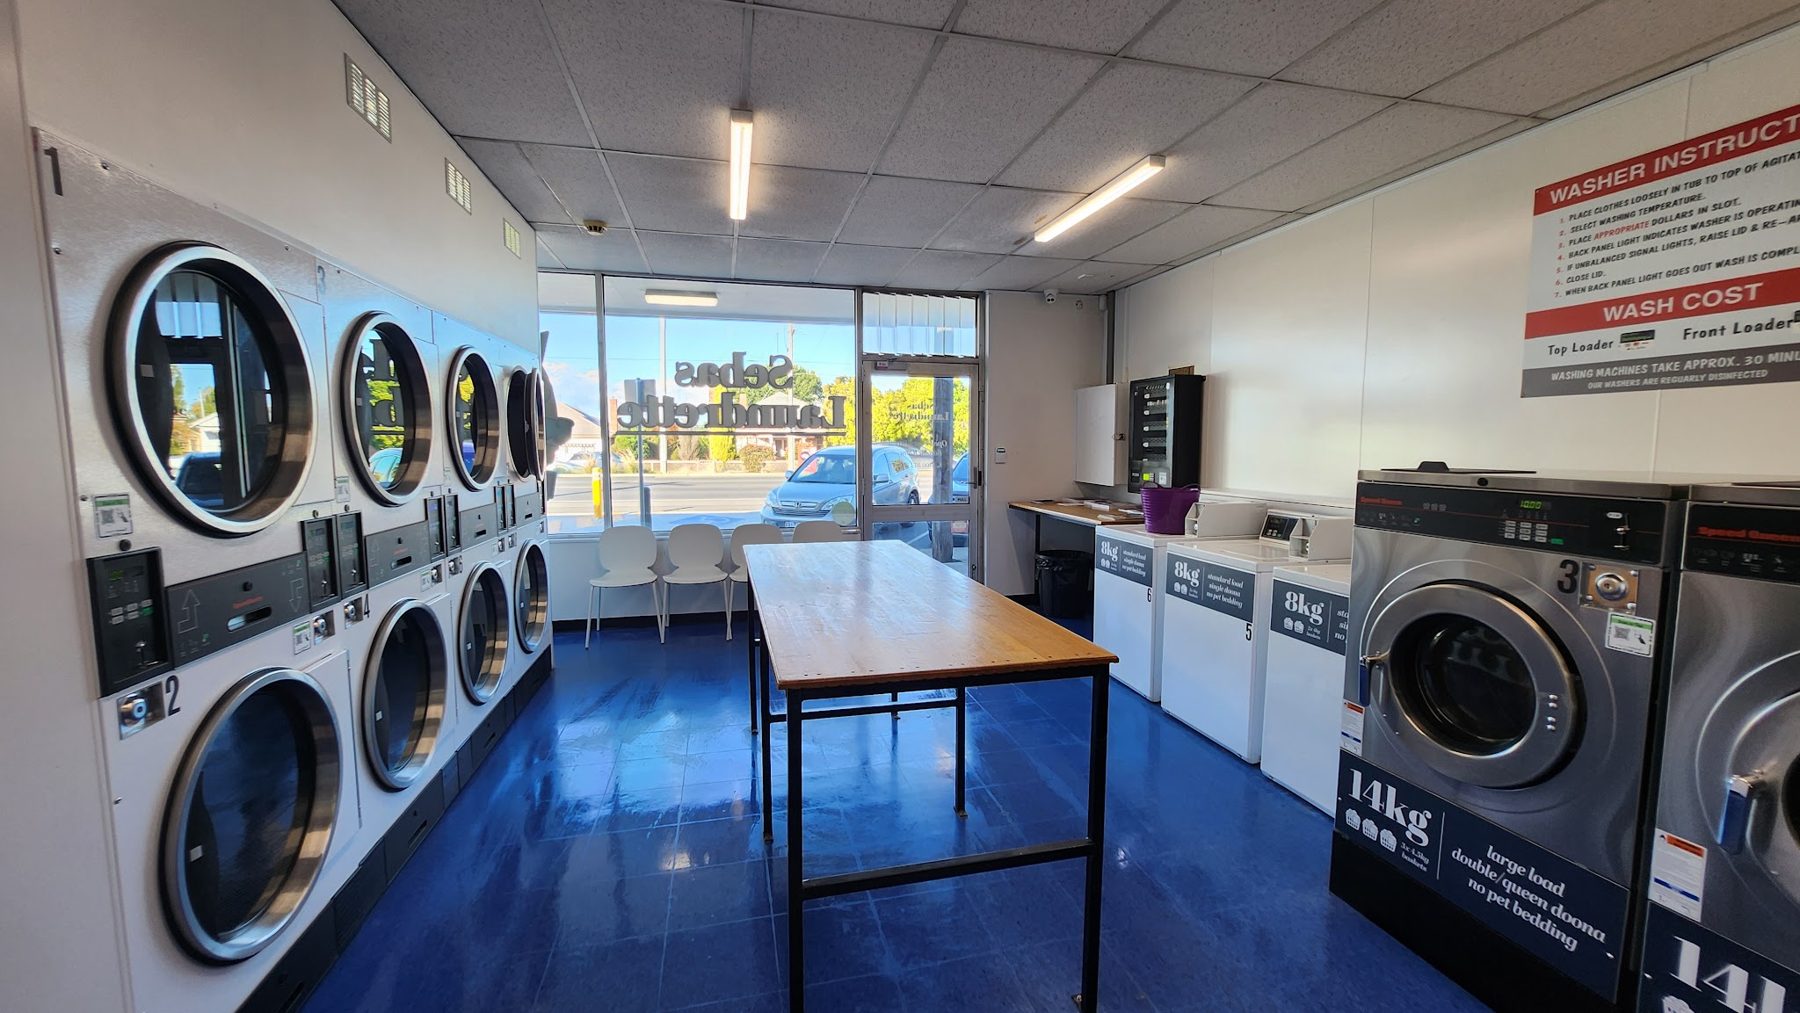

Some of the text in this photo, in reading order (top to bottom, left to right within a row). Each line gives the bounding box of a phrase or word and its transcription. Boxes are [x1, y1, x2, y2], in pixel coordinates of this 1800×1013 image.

[44, 147, 63, 196] 1
[1550, 114, 1800, 204] WASHER INSTRUCT
[1569, 209, 1592, 221] PLACE
[1594, 199, 1629, 215] CLOTHES
[1631, 187, 1669, 204] LOOSELY
[1671, 184, 1681, 193] IN
[1684, 179, 1702, 190] TUB
[1705, 175, 1718, 184] TO
[1721, 167, 1741, 180] TOP
[1745, 162, 1758, 173] OF
[1568, 235, 1592, 246] PLACE
[1594, 220, 1649, 240] APPROPRIATE
[1651, 210, 1694, 226] DOLLARS
[1698, 206, 1708, 215] IN
[1711, 197, 1741, 211] SLOT.
[1570, 221, 1597, 234] SELECT
[1599, 211, 1636, 226] WASHING
[1639, 193, 1705, 216] TEMPERATURE.
[1567, 263, 1574, 271] IF
[1575, 252, 1626, 269] UNBALANCED
[1629, 246, 1659, 258] SIGNAL
[1661, 238, 1697, 252] LIGHTS,
[1700, 230, 1729, 243] RAISE
[1731, 226, 1748, 236] LID
[1751, 224, 1760, 232] &
[1568, 247, 1589, 259] BACK
[1591, 242, 1615, 254] PANEL
[1617, 236, 1640, 248] LIGHT
[1642, 225, 1688, 242] INDICATES
[1690, 215, 1731, 231] WASHER
[1734, 211, 1744, 221] IS
[1565, 286, 1586, 296] WHEN
[1588, 281, 1609, 292] BACK
[1611, 277, 1636, 288] PANEL
[1638, 271, 1663, 283] LIGHT
[1665, 266, 1690, 278] GOES
[1693, 262, 1713, 273] OUT
[1715, 256, 1745, 268] WASH
[1748, 254, 1758, 262] IS
[1566, 273, 1590, 284] CLOSE
[1591, 270, 1607, 279] LID.
[1603, 282, 1764, 322] WASH COST
[1548, 344, 1567, 356] Top
[1572, 339, 1614, 353] Loader
[1683, 318, 1793, 340] Front Loader
[1551, 369, 1594, 381] WASHING
[1596, 364, 1648, 377] MACHINES
[1651, 361, 1680, 373] TAKE
[1683, 356, 1740, 371] APPROX.
[1745, 354, 1763, 366] 30
[1588, 381, 1602, 389] OUR
[1604, 379, 1641, 388] WASHERS
[1642, 377, 1658, 386] ARE
[1708, 369, 1769, 381] DISINFECTED
[1101, 541, 1118, 561] 8kg
[1174, 561, 1200, 587] 8kg
[1557, 559, 1579, 593] 3
[1147, 588, 1152, 602] 6
[1285, 591, 1324, 625] 8kg
[1246, 623, 1252, 641] 5
[165, 675, 181, 716] 2
[1348, 768, 1432, 847] 14kg
[1487, 845, 1566, 897] large load
[1451, 848, 1606, 943] double/queen doona
[1468, 878, 1578, 951] no pet bedding
